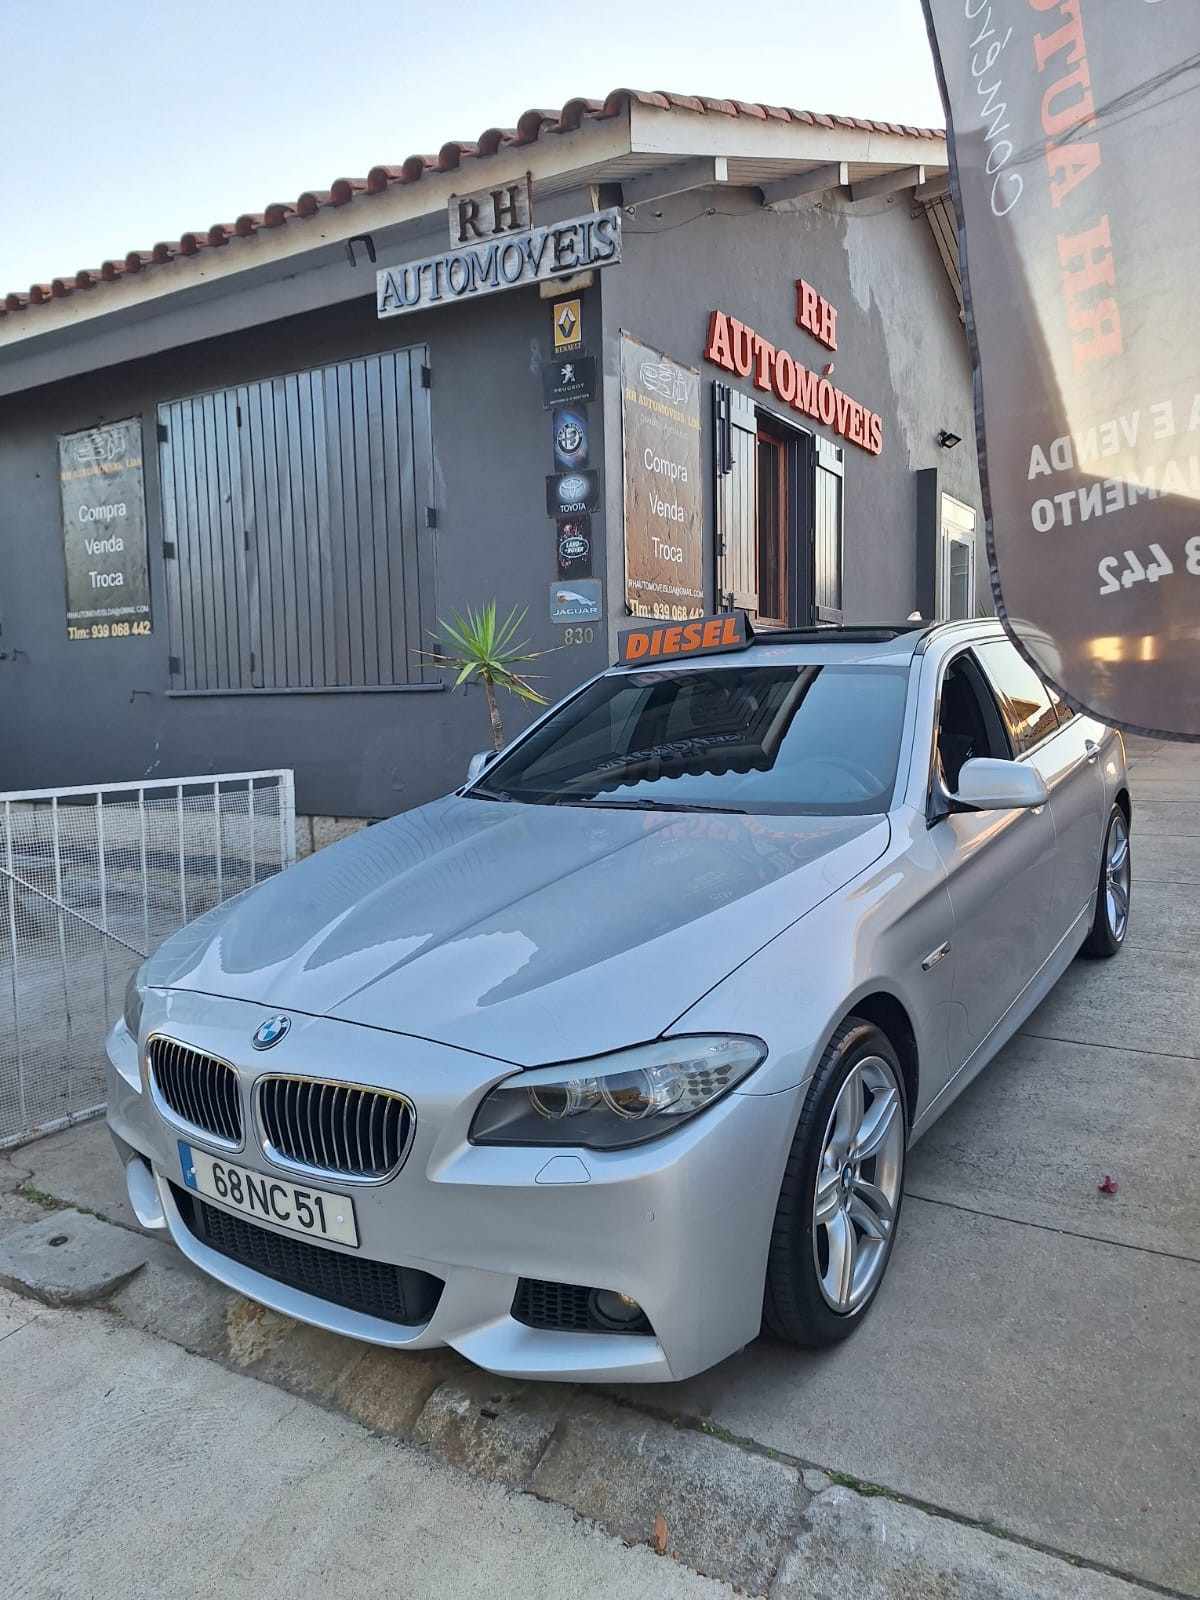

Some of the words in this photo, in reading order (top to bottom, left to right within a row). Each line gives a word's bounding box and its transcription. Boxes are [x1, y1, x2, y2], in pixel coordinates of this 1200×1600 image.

[458, 186, 520, 241] RH
[379, 219, 616, 311] AUTOMOVEIS
[796, 278, 838, 350] RH
[705, 310, 882, 455] AUTOMÓVEIS
[644, 448, 688, 482] Compra
[79, 502, 127, 523] Compra
[560, 502, 587, 512] TOYOTA
[650, 493, 684, 522] Venda
[85, 536, 124, 555] Venda
[652, 537, 683, 563] Troca
[89, 571, 124, 588] Troca
[553, 607, 598, 616] JAGUAR
[653, 602, 670, 619] 939
[672, 605, 688, 620] 068
[91, 624, 109, 637] 939
[111, 623, 129, 636] 068
[132, 620, 151, 634] 442
[564, 628, 594, 646] 830
[626, 618, 740, 659] DIESEL
[212, 1162, 327, 1234] 68NC51
